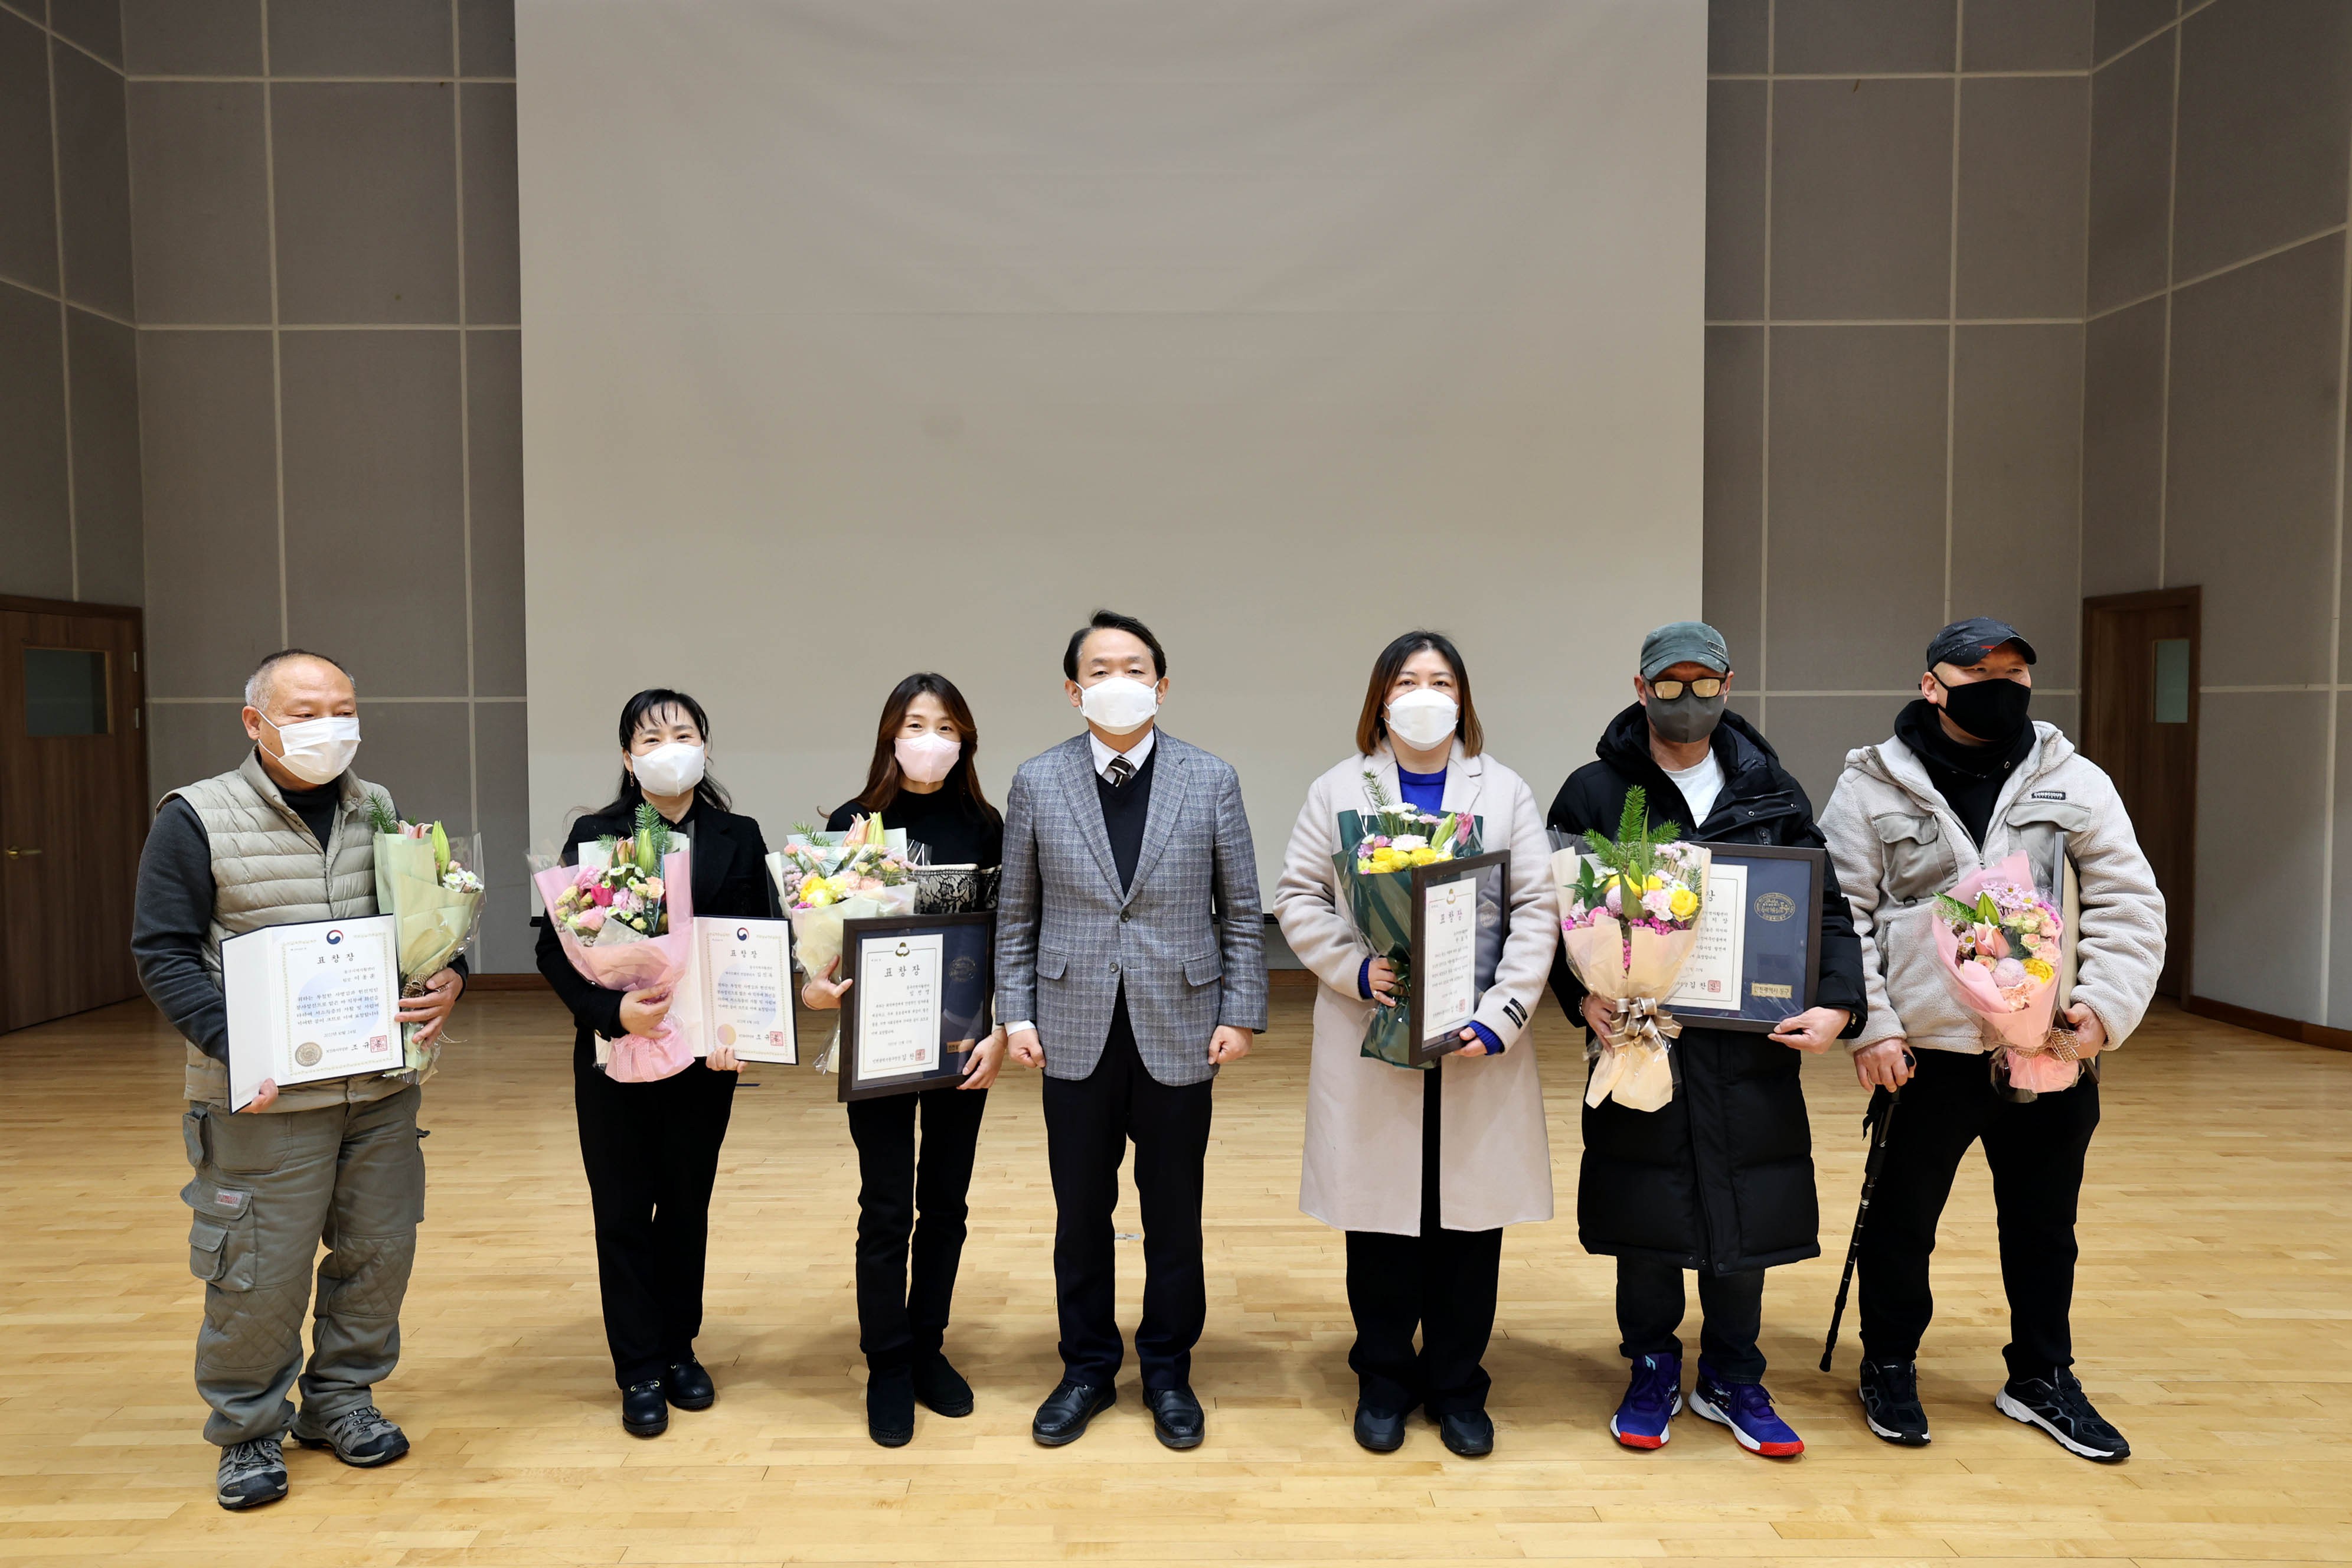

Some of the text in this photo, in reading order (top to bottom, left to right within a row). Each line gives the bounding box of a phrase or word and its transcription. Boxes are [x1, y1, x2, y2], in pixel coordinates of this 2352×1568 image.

[317, 952, 355, 964] 표창장
[730, 949, 757, 959] 표창장
[884, 964, 920, 977] 표창장
[1753, 985, 1778, 994] 인천광역시
